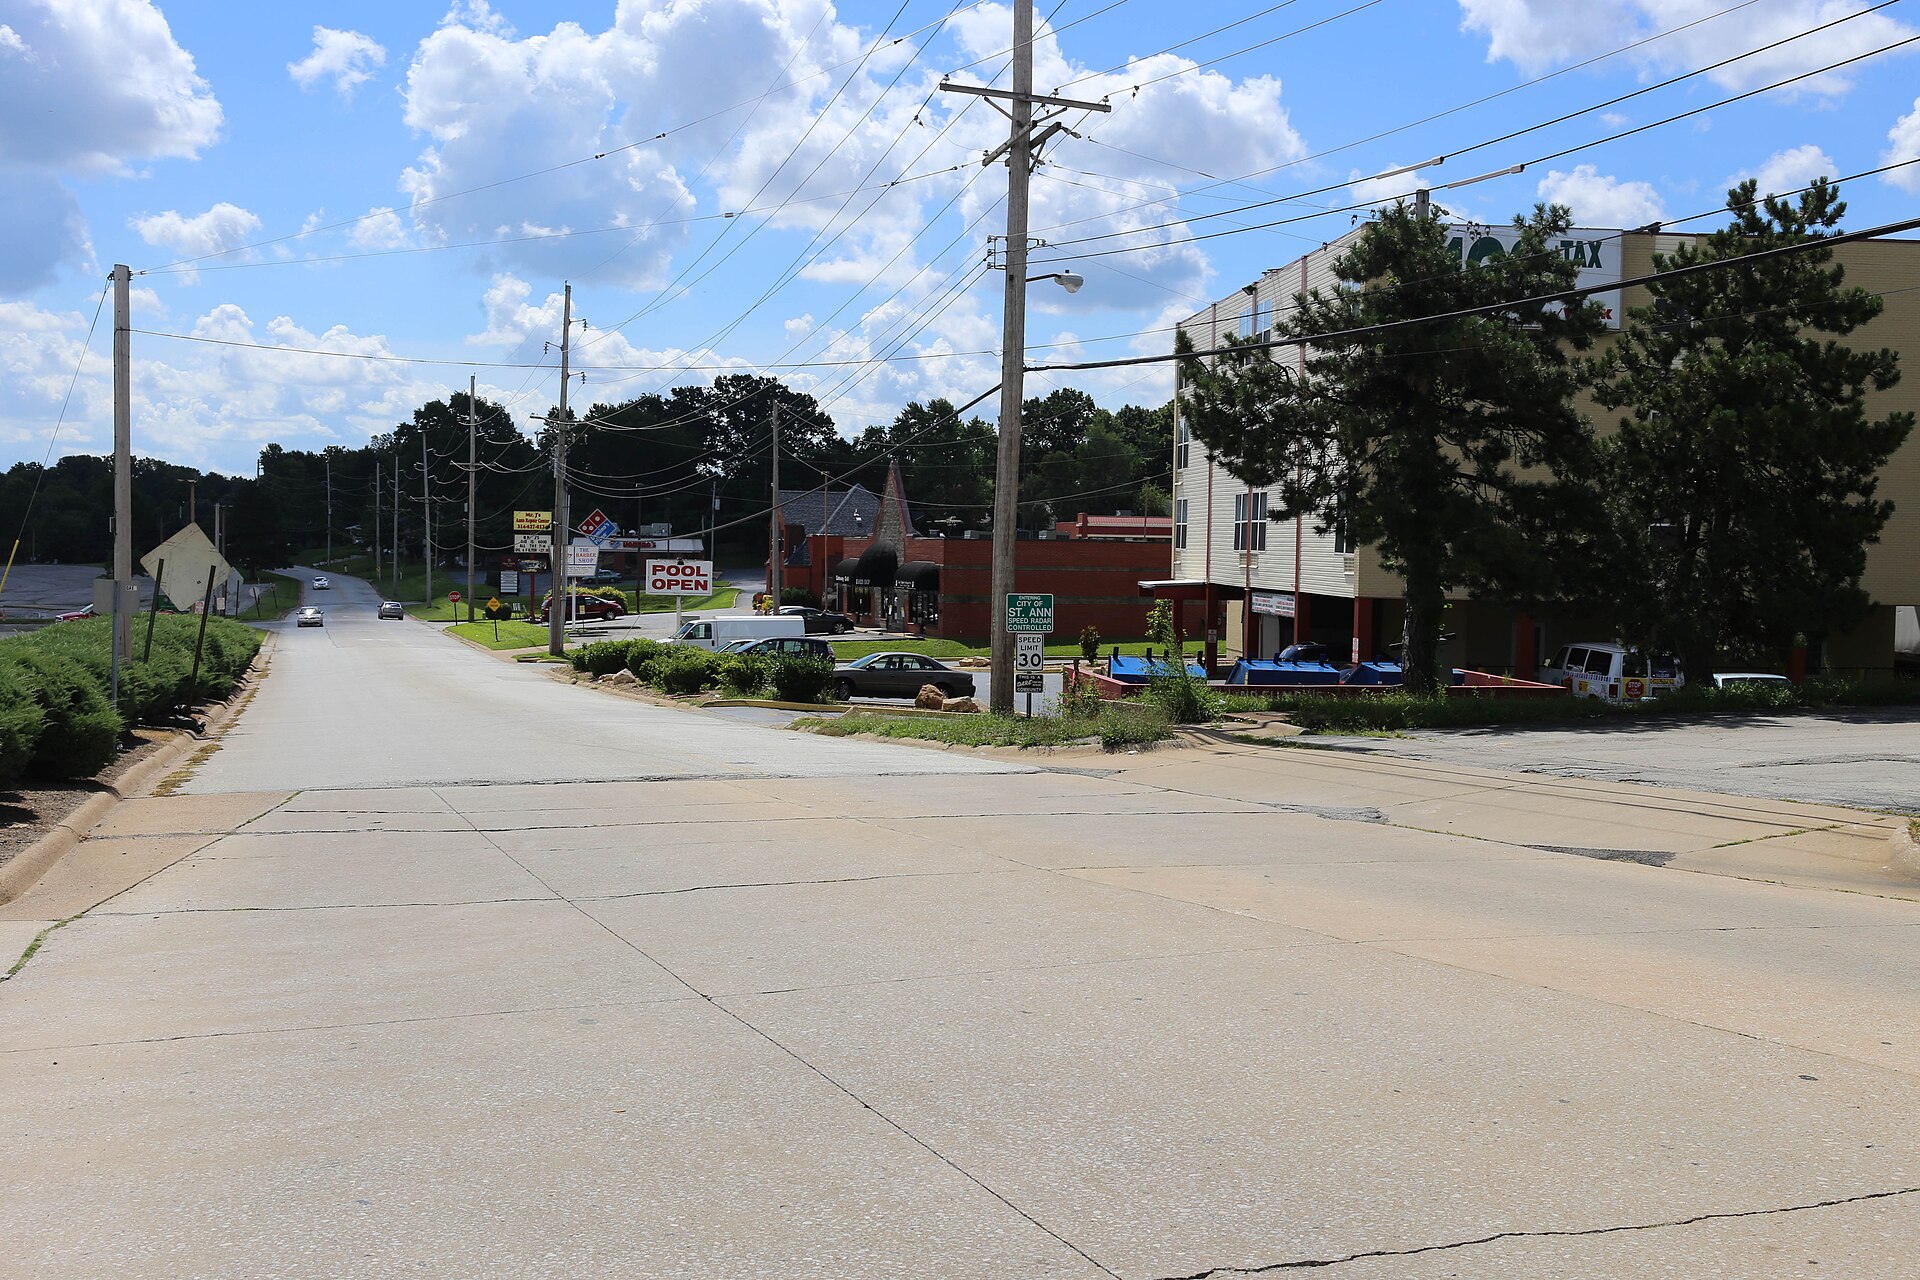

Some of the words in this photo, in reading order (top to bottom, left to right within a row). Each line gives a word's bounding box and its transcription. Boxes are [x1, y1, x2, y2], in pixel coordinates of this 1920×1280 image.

[652, 565, 708, 577] POOL
[651, 579, 708, 591] OPEN
[1008, 607, 1025, 617] ST.
[1029, 607, 1051, 617] ANN
[1018, 653, 1042, 667] 30
